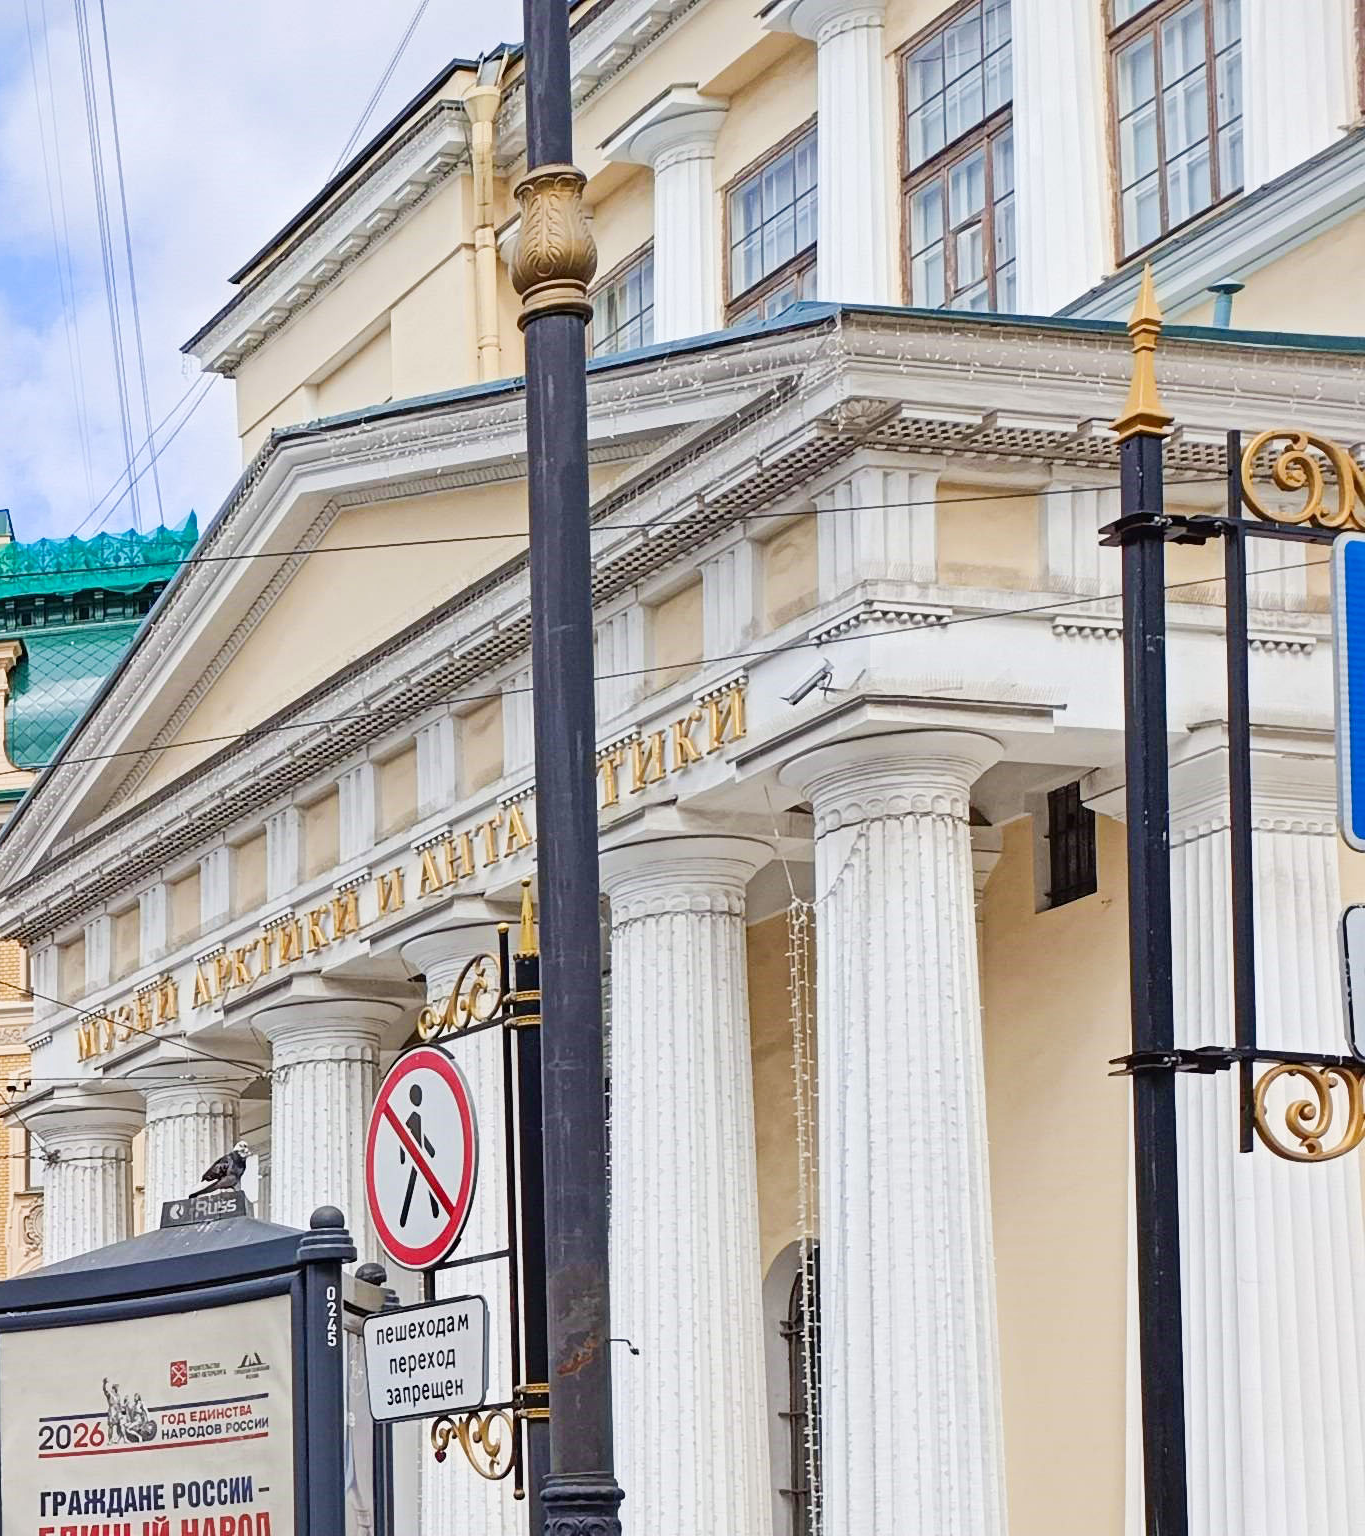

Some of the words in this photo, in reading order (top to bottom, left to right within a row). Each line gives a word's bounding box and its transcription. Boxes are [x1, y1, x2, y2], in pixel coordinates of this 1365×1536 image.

[76, 973, 179, 1063] МУЗЕЙ
[192, 889, 358, 1009] АРКТИКИ
[374, 867, 405, 918] И
[418, 687, 748, 898] АНТАТИКИ
[326, 1286, 337, 1347] 0245
[376, 1313, 469, 1345] пешеходам
[389, 1348, 456, 1379] переход
[386, 1378, 464, 1407] запрещен
[161, 1412, 186, 1426] ГОД
[190, 1404, 253, 1422] ЕДИНСТВА
[161, 1423, 222, 1441] НАРОДОВ
[225, 1416, 270, 1433] РОССИИ
[38, 1421, 106, 1451] 2026
[40, 1484, 166, 1518] ГРАЖДАНЕ
[172, 1475, 254, 1509] РОССИИ
